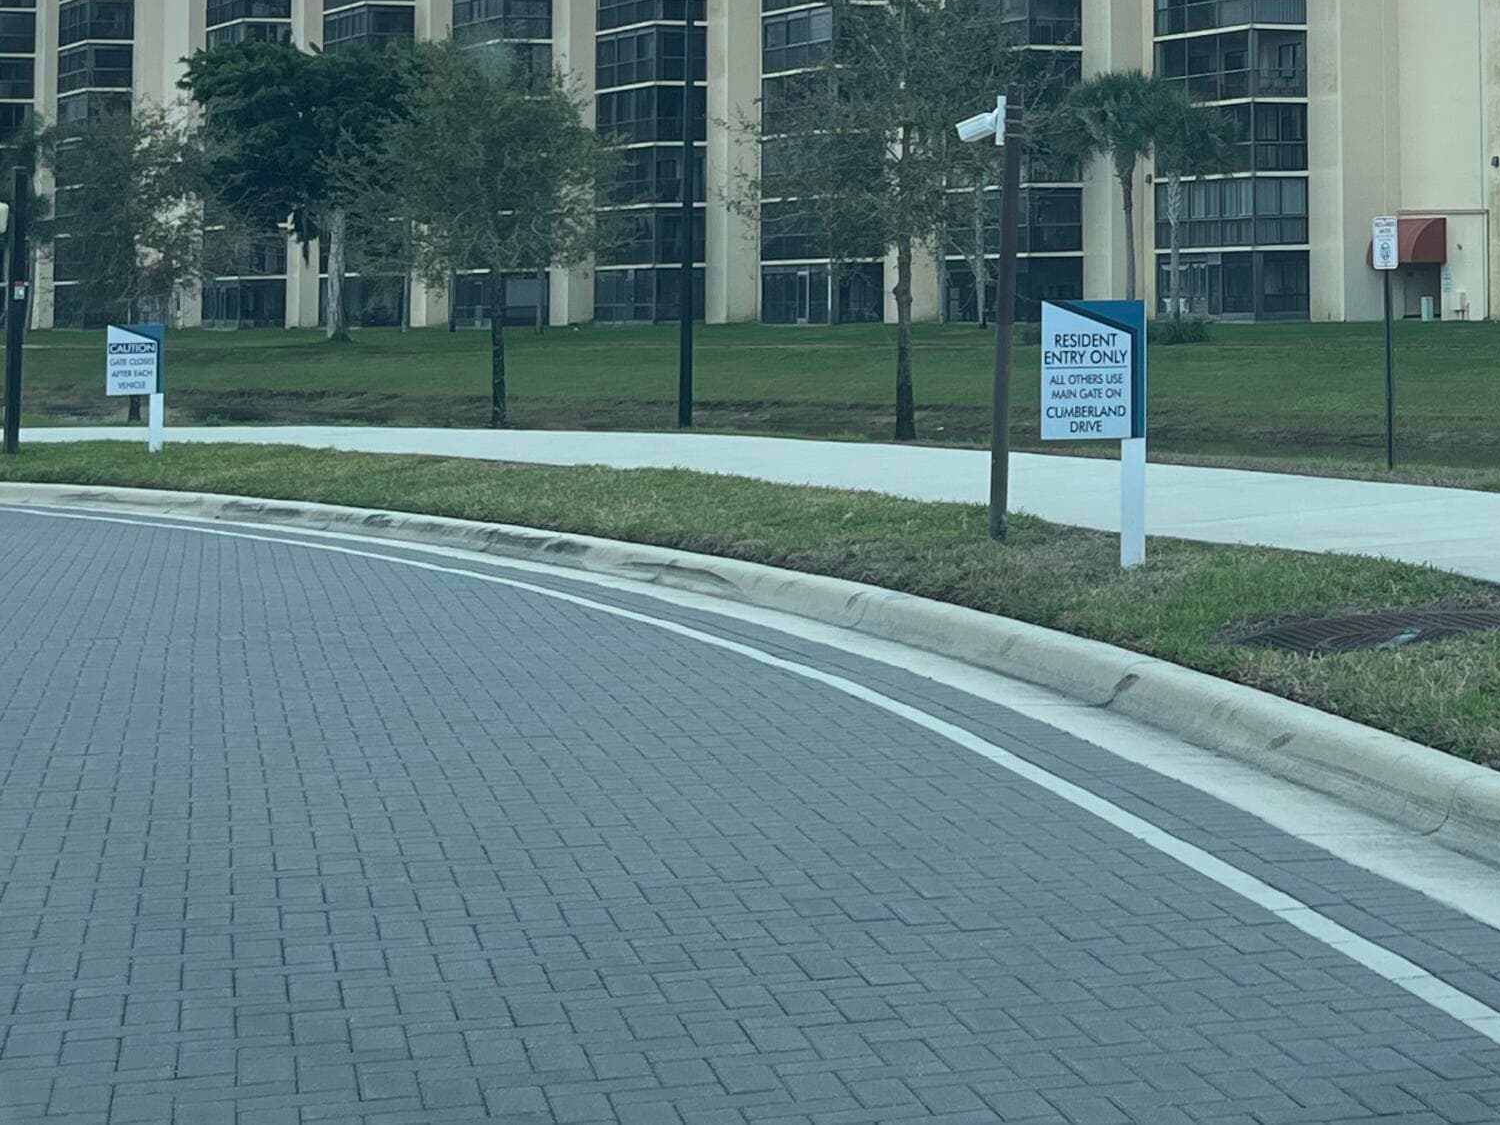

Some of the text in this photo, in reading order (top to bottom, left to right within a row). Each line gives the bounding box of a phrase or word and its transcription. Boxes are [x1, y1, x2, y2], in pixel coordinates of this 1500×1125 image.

[1054, 333, 1118, 348] RESIDENT
[109, 344, 155, 353] CAUTION
[110, 358, 126, 366] GATE
[1044, 349, 1128, 365] ENTRY ONLY
[133, 369, 153, 377] EACH
[1050, 373, 1124, 385] ALL OTHERS USE
[118, 381, 145, 389] VEHICLE
[1051, 388, 1122, 400] MAIN GATE ON
[1046, 405, 1127, 419] CUMBERLAND
[1069, 420, 1103, 433] DRIVE
